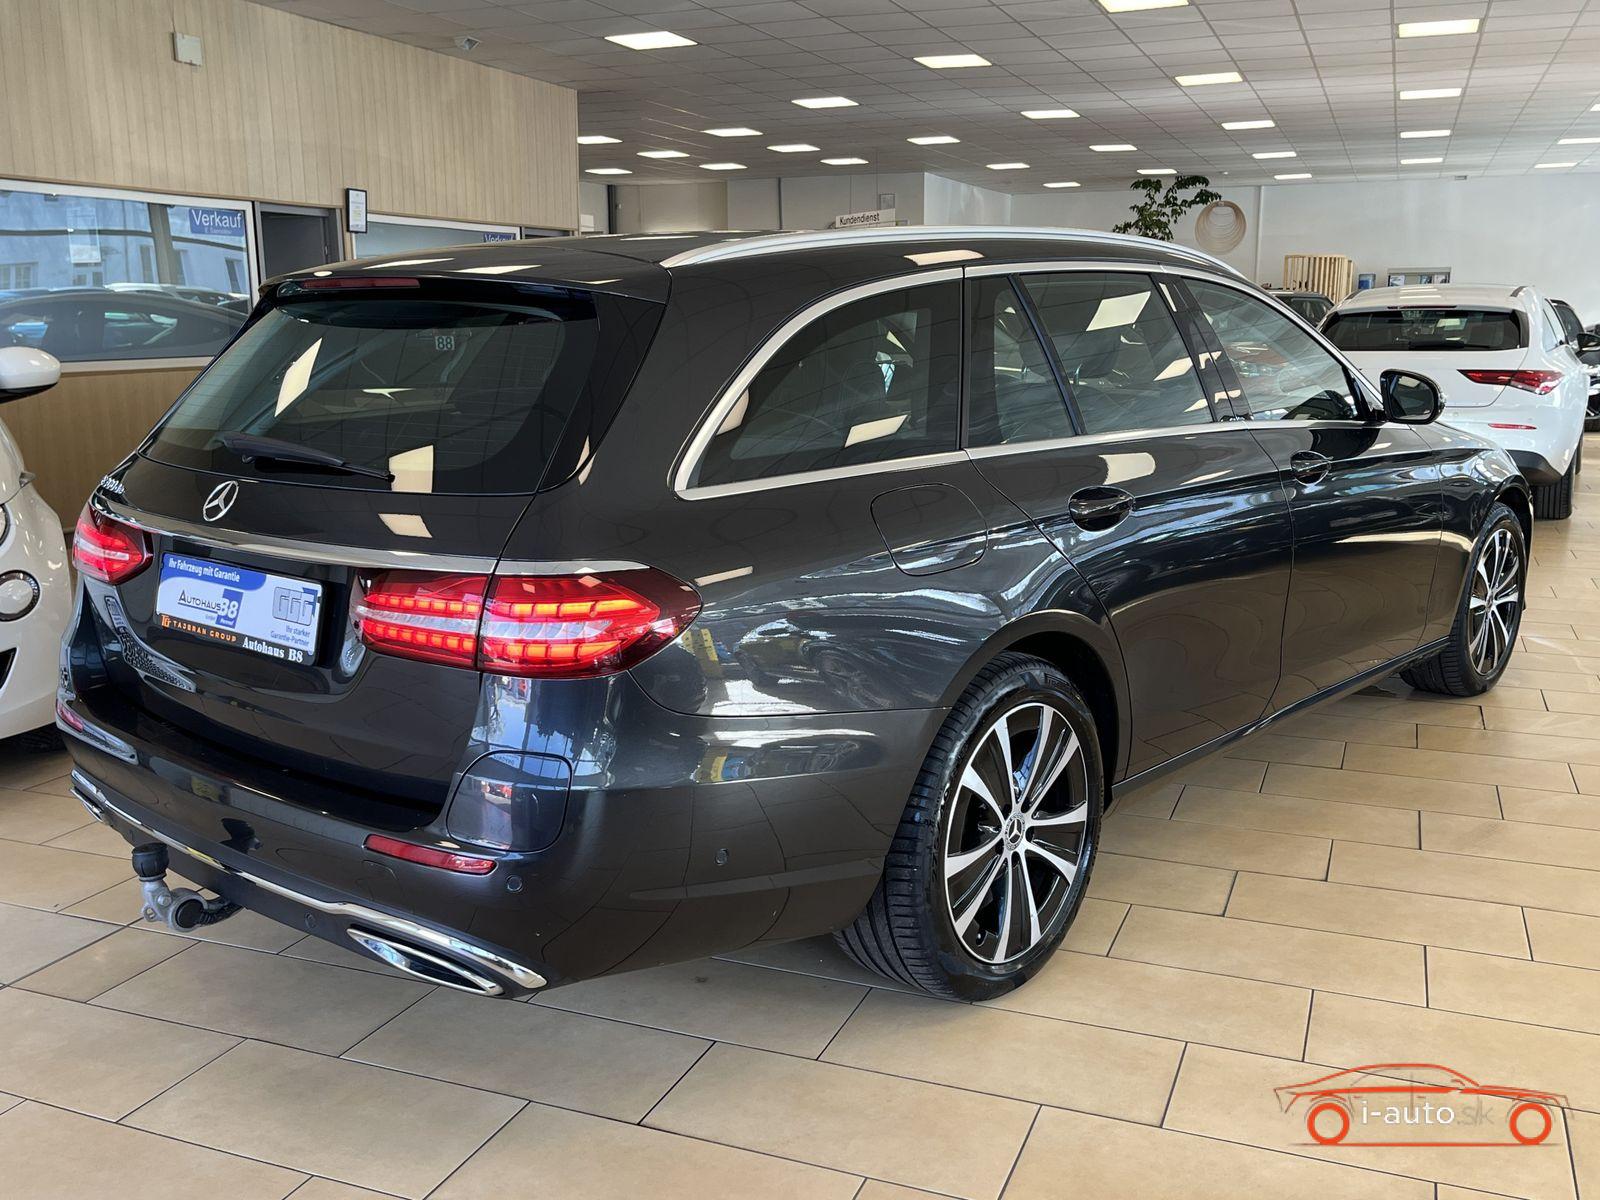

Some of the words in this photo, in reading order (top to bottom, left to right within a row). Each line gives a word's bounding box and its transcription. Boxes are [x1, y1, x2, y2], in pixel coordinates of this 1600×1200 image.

[191, 209, 242, 228] Verkauf
[839, 212, 880, 225] Kundendienst
[168, 557, 177, 569] Ihr
[177, 559, 203, 576] Fahrzeug
[202, 566, 214, 576] mit
[213, 567, 240, 582] Garantie
[209, 630, 237, 642] GROUP
[242, 636, 285, 658] Autohaus
[288, 648, 303, 663] B8
